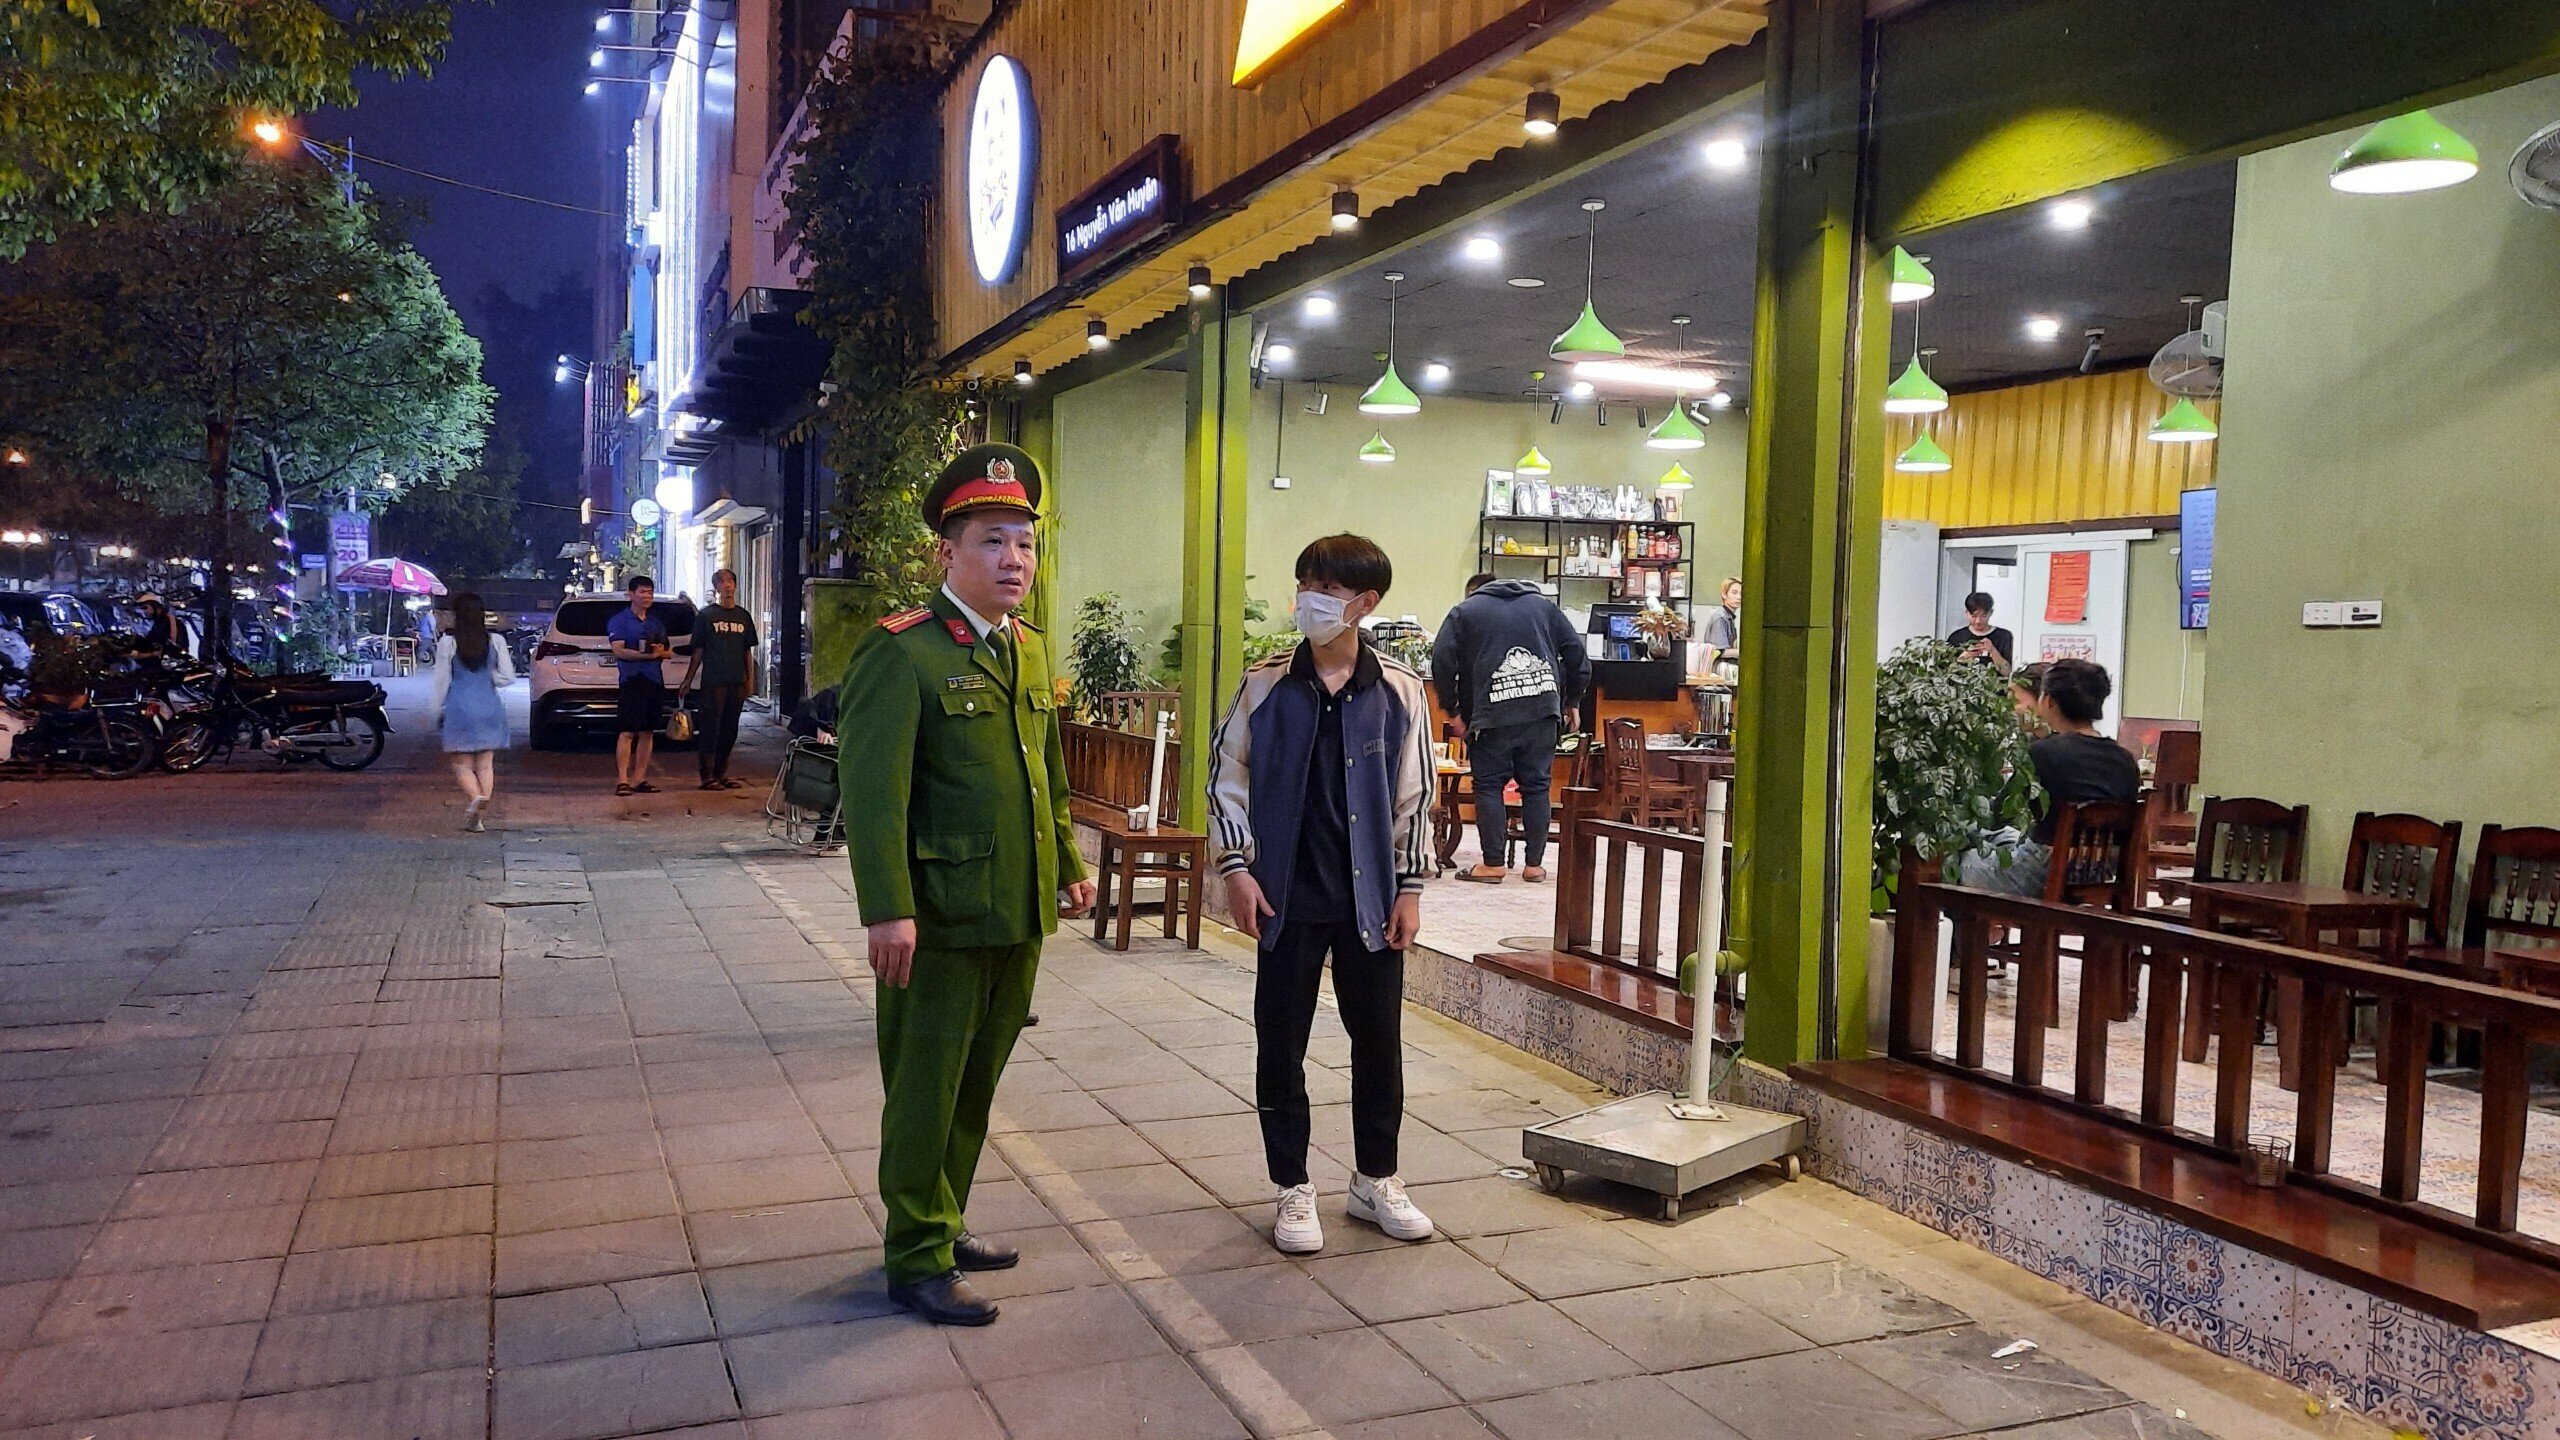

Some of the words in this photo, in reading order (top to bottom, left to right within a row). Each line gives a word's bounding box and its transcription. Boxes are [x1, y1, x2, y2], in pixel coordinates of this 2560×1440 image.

[1065, 229, 1076, 254] 16
[1076, 204, 1108, 249] Nguyễn
[1108, 197, 1127, 225] Văn
